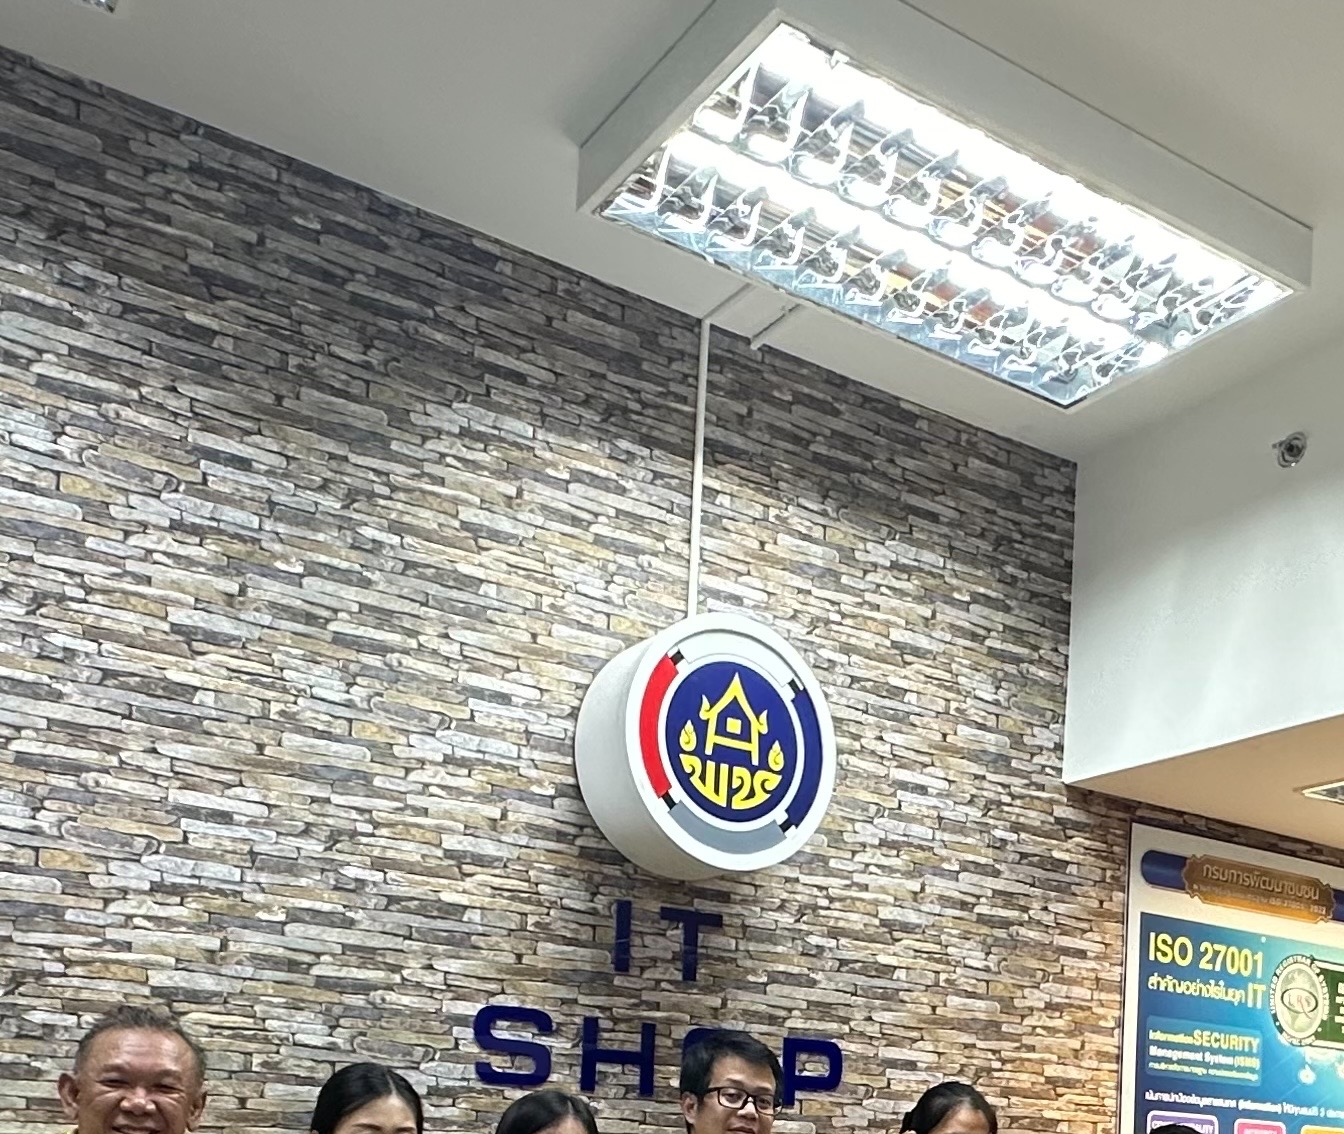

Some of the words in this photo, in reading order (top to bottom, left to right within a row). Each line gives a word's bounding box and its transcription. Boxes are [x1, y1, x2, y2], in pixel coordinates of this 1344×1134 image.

[613, 900, 723, 981] IT
[1149, 932, 1193, 967] ISO
[1199, 941, 1263, 978] 27001
[1247, 983, 1266, 1009] IT
[473, 1004, 843, 1108] SHP
[1193, 1029, 1260, 1054] SECURITY
